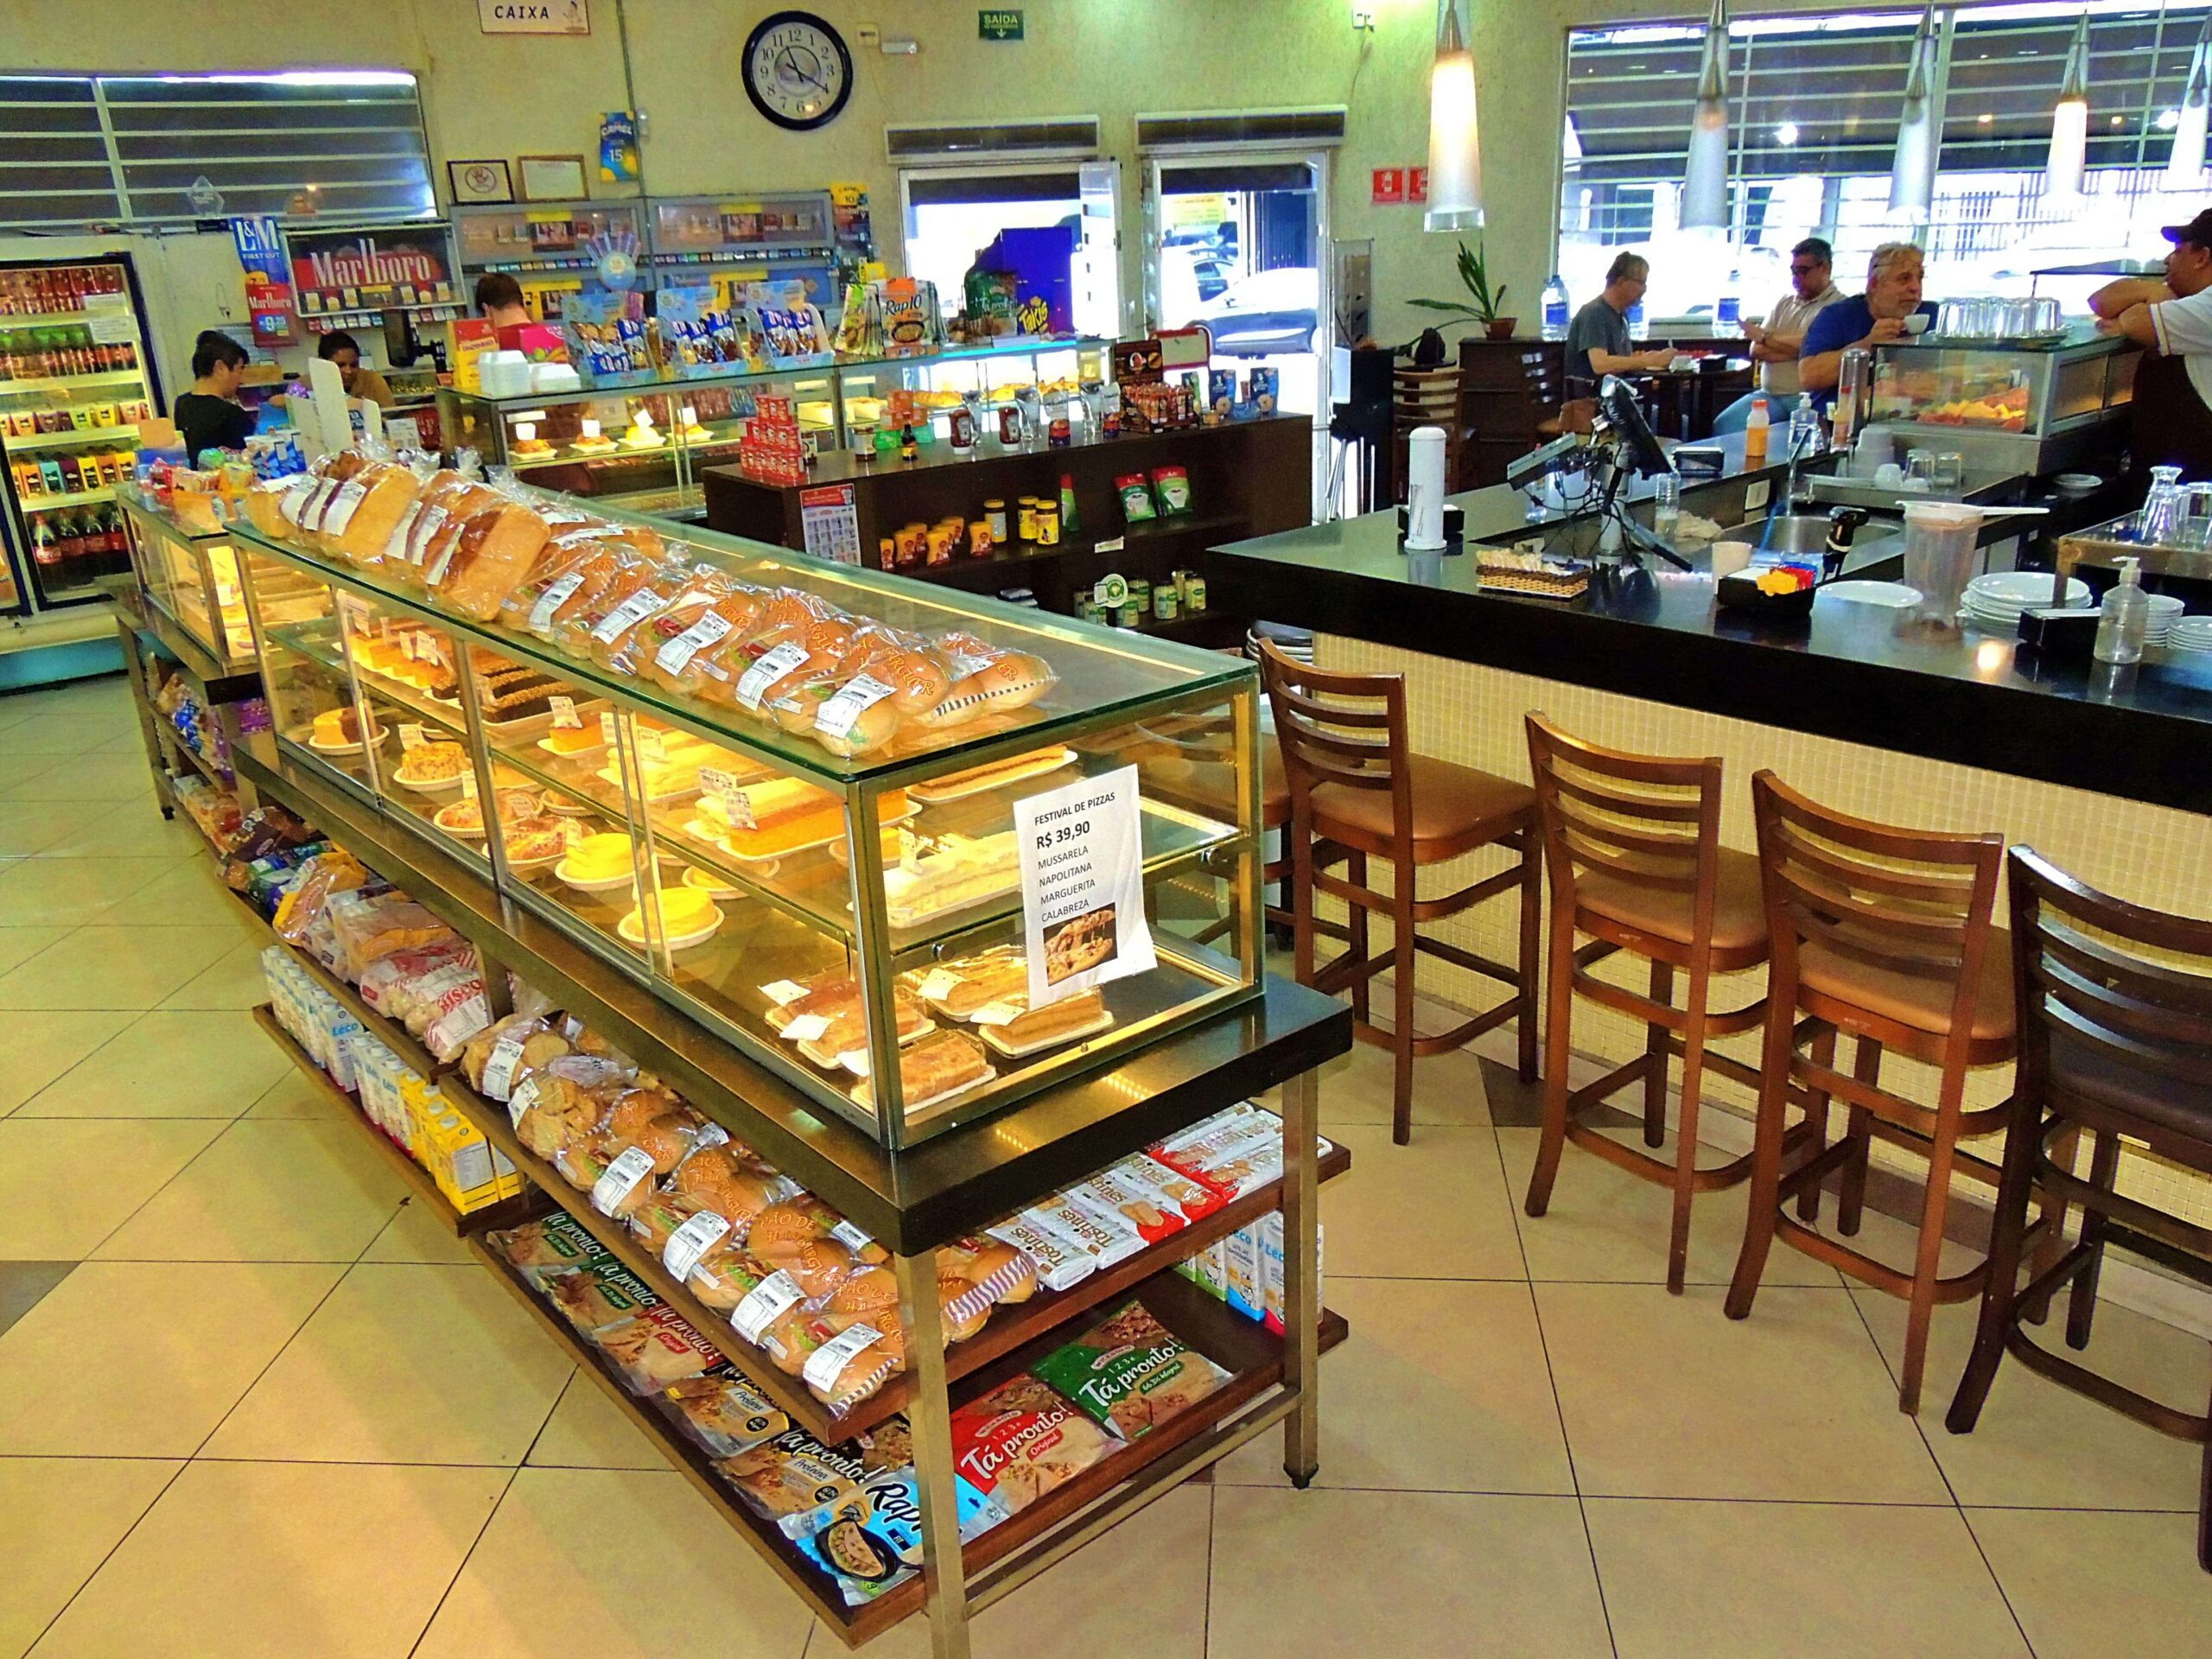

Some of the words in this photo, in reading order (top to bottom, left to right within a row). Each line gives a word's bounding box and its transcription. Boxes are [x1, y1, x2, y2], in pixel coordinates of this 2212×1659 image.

[494, 5, 550, 19] CAIXA
[773, 35, 783, 47] 11
[789, 29, 801, 41] 12
[810, 34, 814, 46] 1
[762, 48, 774, 60] 10
[822, 47, 829, 60] 2
[760, 67, 768, 79] 9
[827, 64, 835, 76] 3
[767, 83, 776, 96] 8
[779, 96, 787, 109] 7
[797, 100, 805, 112] 6
[608, 149, 623, 162] 15
[236, 219, 279, 252] L&M
[310, 238, 431, 289] Marlboro
[248, 292, 292, 309] Marlboro
[886, 295, 923, 315] Rap10
[1019, 301, 1047, 334] Takis
[1034, 807, 1073, 826] FESTIVAL
[1074, 802, 1086, 813] DE
[1088, 791, 1116, 810] PIZZAS
[1037, 832, 1052, 850] R$
[1056, 820, 1091, 844] 39,90
[1038, 844, 1090, 870] MUSSARELA
[1039, 861, 1093, 888] NAPOLITANA
[1039, 878, 1096, 906] MARGUERITA
[1041, 899, 1090, 923] CALABREZA
[332, 1022, 358, 1037] Leco
[1058, 1209, 1116, 1248] Tostines
[1011, 1227, 1069, 1267] Tostines
[1078, 1377, 1121, 1407] Tá
[1117, 1337, 1185, 1390] pronto!
[960, 1445, 1003, 1479] Tá
[1001, 1402, 1074, 1459] pronto!
[1030, 1431, 1059, 1455] Original
[792, 1441, 888, 1484] pronto!
[865, 1482, 921, 1532] Rap
